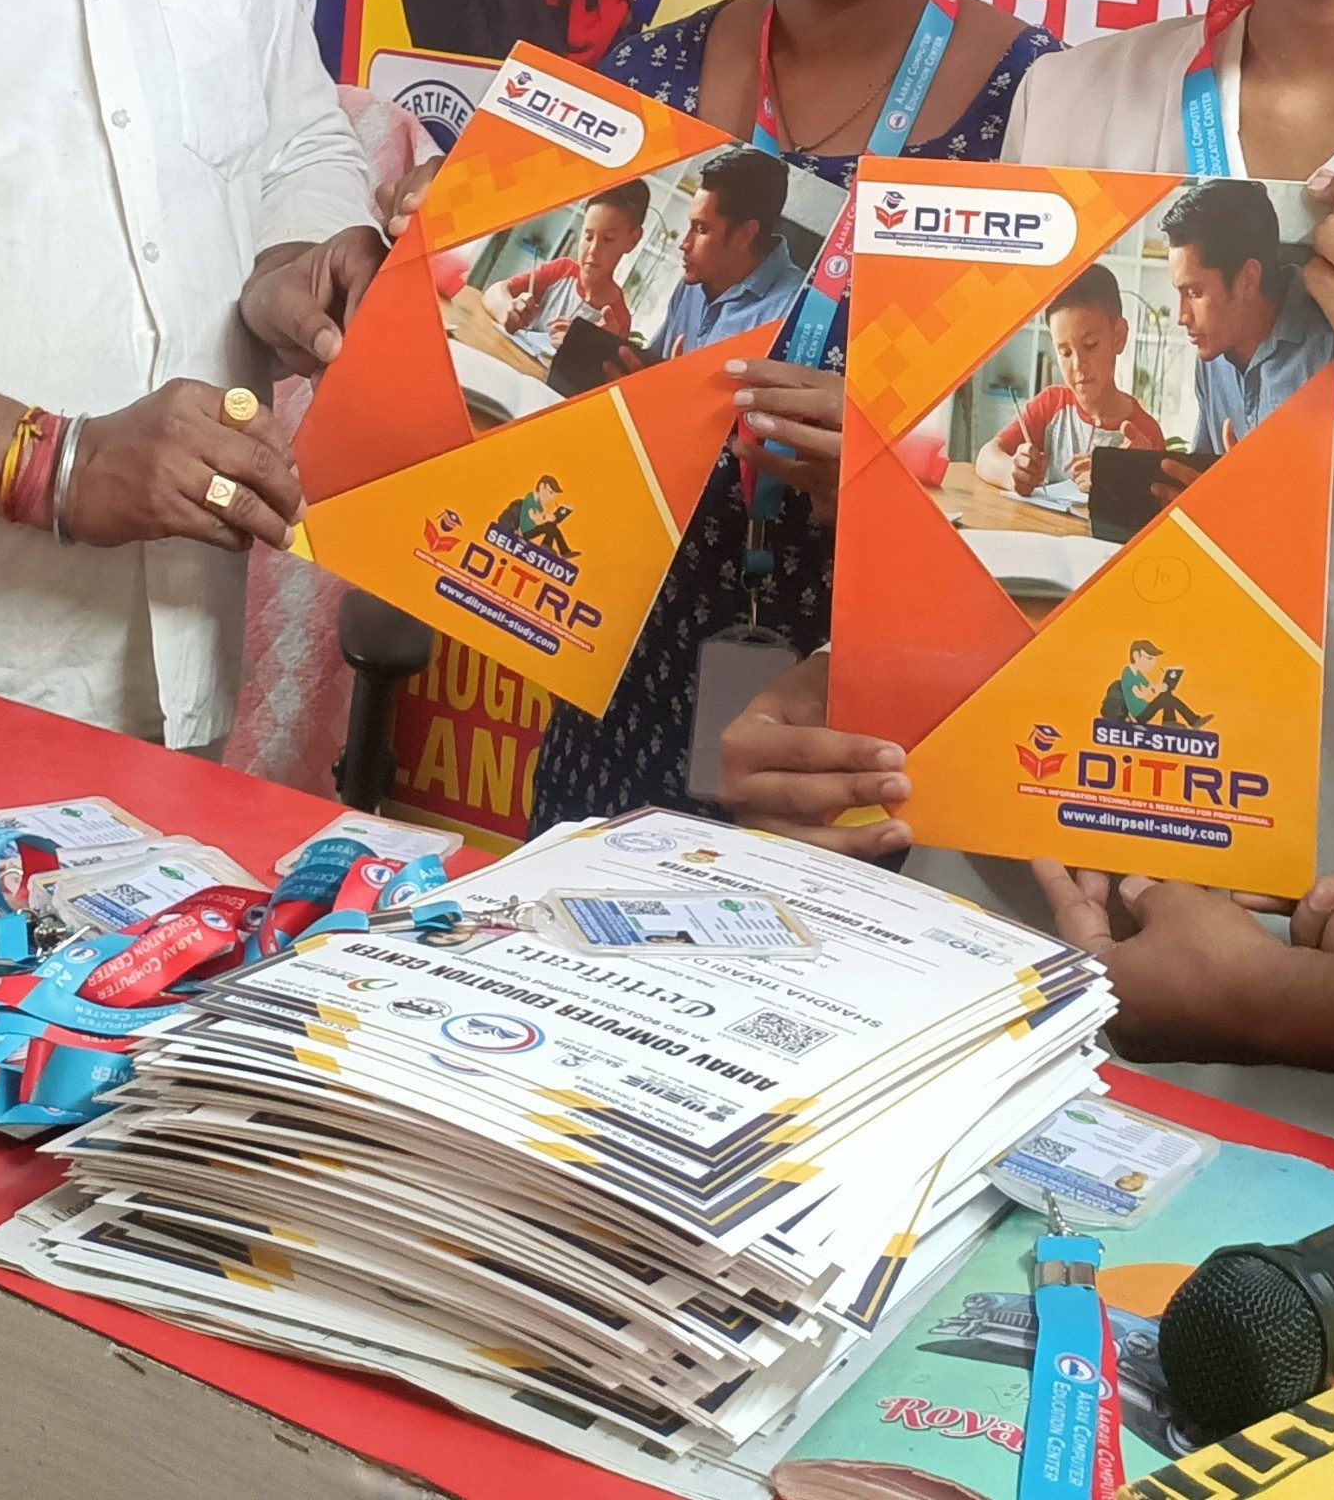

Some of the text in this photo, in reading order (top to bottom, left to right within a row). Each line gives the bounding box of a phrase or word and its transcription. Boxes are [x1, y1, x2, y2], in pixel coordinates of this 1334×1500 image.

[794, 322, 811, 365] OMPUTER
[487, 530, 576, 582] SELF-STUDY
[440, 581, 557, 652] www.ditrpself-study.com
[1097, 728, 1217, 756] SELF-STUDY
[1020, 785, 1047, 795] DIGITAL
[1049, 788, 1097, 801] INFORMATION
[1098, 795, 1147, 808] TECHNOLOGY
[1156, 803, 1195, 815] RESEARCH
[1197, 808, 1212, 817] FOR
[1214, 811, 1270, 826] PROFESSIONAL
[1063, 810, 1228, 842] www.ditrpself-study.com
[655, 860, 913, 944] AARAV COMPUTER CENTER
[341, 941, 778, 1091] AARAV COMPUTER EDUCATION CENTER
[709, 962, 882, 1027] SHARDHA TIWARI
[878, 1397, 1025, 1453] Roya
